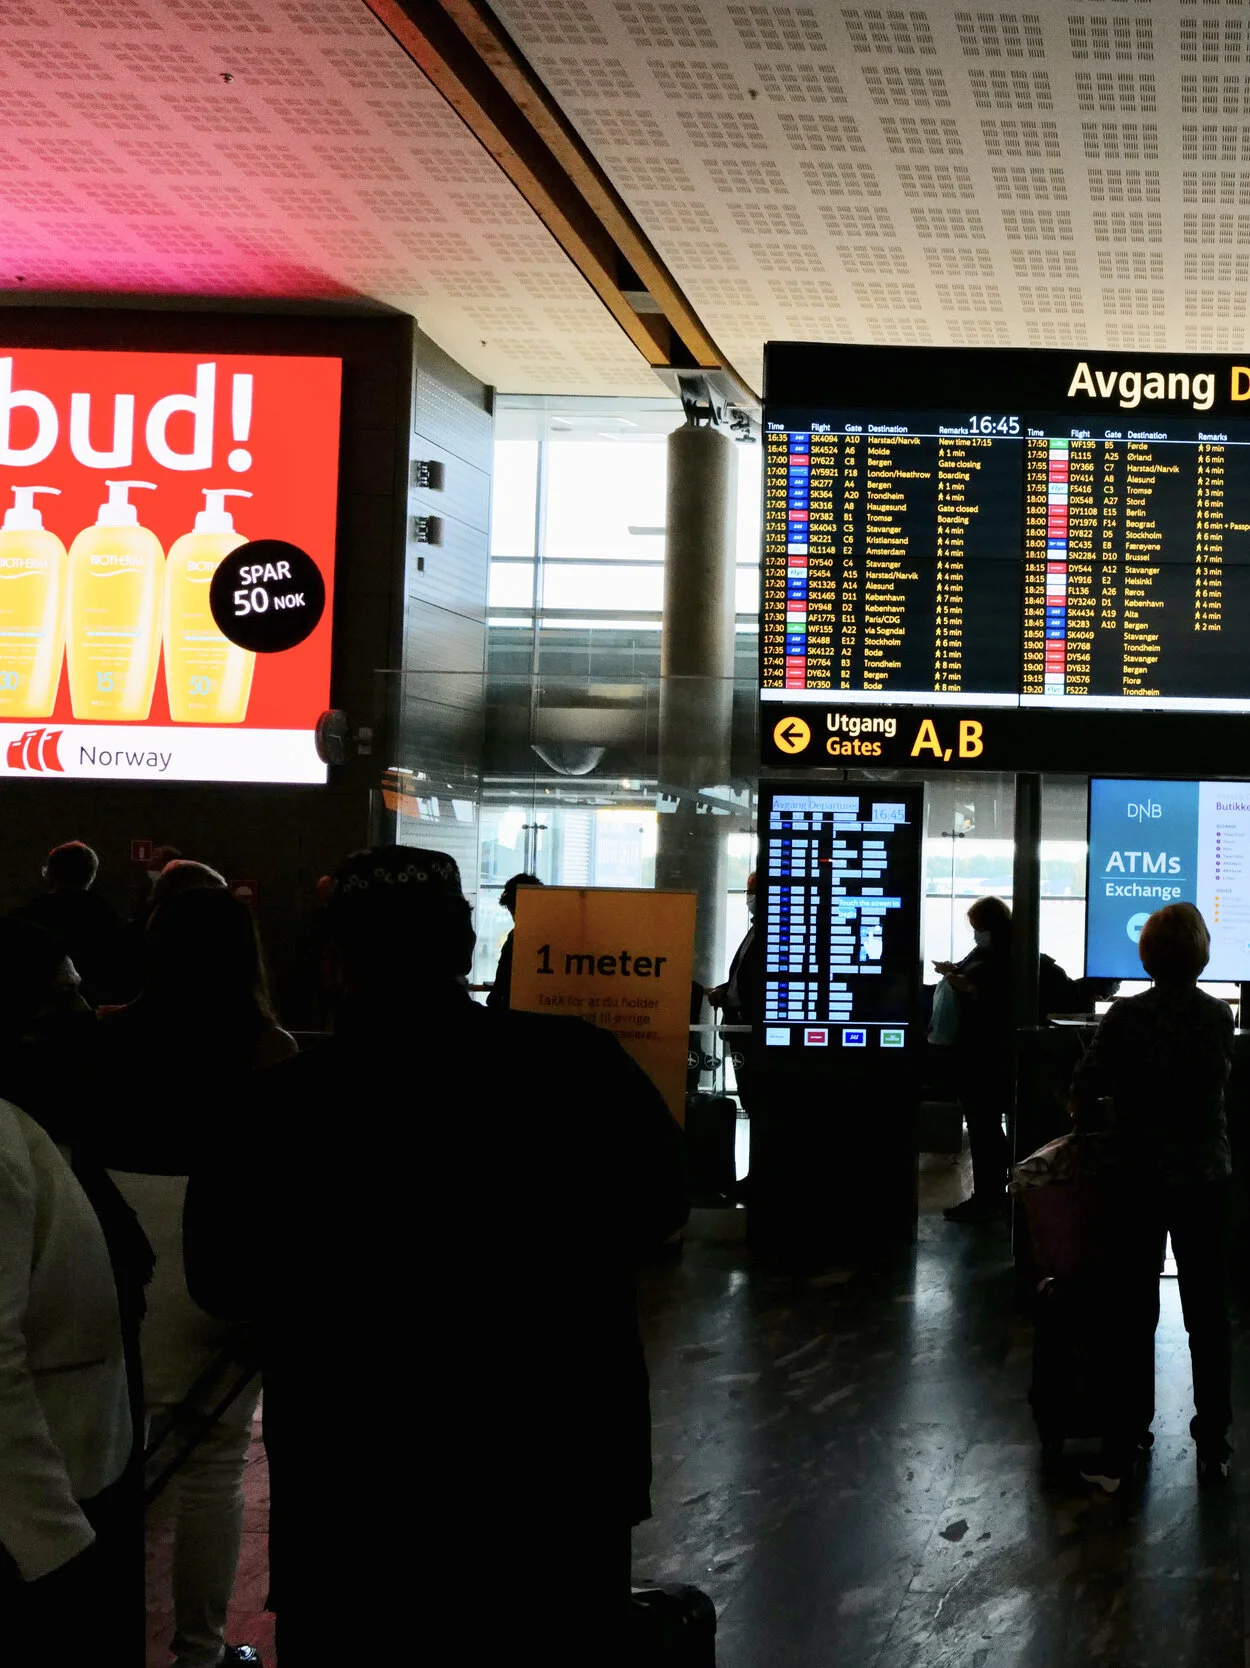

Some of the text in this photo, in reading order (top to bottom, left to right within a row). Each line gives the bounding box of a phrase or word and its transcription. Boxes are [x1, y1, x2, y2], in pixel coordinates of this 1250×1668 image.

[1068, 362, 1216, 411] Avgang
[767, 423, 969, 435] Time Flight Gate Destination Remarks
[969, 415, 1020, 434] 16:45
[767, 433, 788, 442] 16:35
[867, 434, 921, 446] Harstad/Narvik
[938, 437, 955, 446] New
[955, 438, 972, 446] time
[971, 438, 993, 447] 17:15
[1027, 429, 1227, 442] Time Flight Gate Destination Remarks
[767, 455, 788, 464] 17:00
[867, 457, 893, 468] Bergen
[938, 459, 956, 468] Gate
[956, 460, 982, 470] closing
[766, 467, 788, 476] 17:00
[867, 469, 931, 479] London/Heathrow
[938, 471, 970, 481] Boarding
[765, 511, 787, 520] 17:15
[866, 513, 893, 522] Tromsø
[937, 515, 970, 525] Boarding
[0, 558, 48, 569] IOTHERM
[90, 554, 144, 567] BIOTHERM
[240, 561, 291, 585] SPAR
[234, 584, 305, 615] 50 NOK
[1023, 629, 1045, 639] 18:50
[1123, 632, 1159, 642] Stavanger
[1023, 640, 1045, 650] 19:00
[1123, 643, 1161, 653] Trondheim
[1023, 651, 1044, 661] 19:00
[1123, 654, 1159, 665] Stavanger
[96, 671, 115, 693] 15
[188, 675, 211, 695] 50
[1023, 674, 1046, 683] 19:15
[1122, 676, 1142, 685] Florø
[826, 713, 983, 761] Utgang A,B
[826, 738, 882, 757] Gates
[79, 746, 173, 771] Norway
[773, 800, 807, 810] Avgang
[1128, 798, 1162, 823] DNB
[1106, 852, 1180, 873] ATMs
[1105, 882, 1181, 901] Exchange
[859, 899, 871, 907] the
[536, 944, 667, 978] 1 meter
[603, 996, 619, 1009] du
[621, 996, 660, 1010] holder
